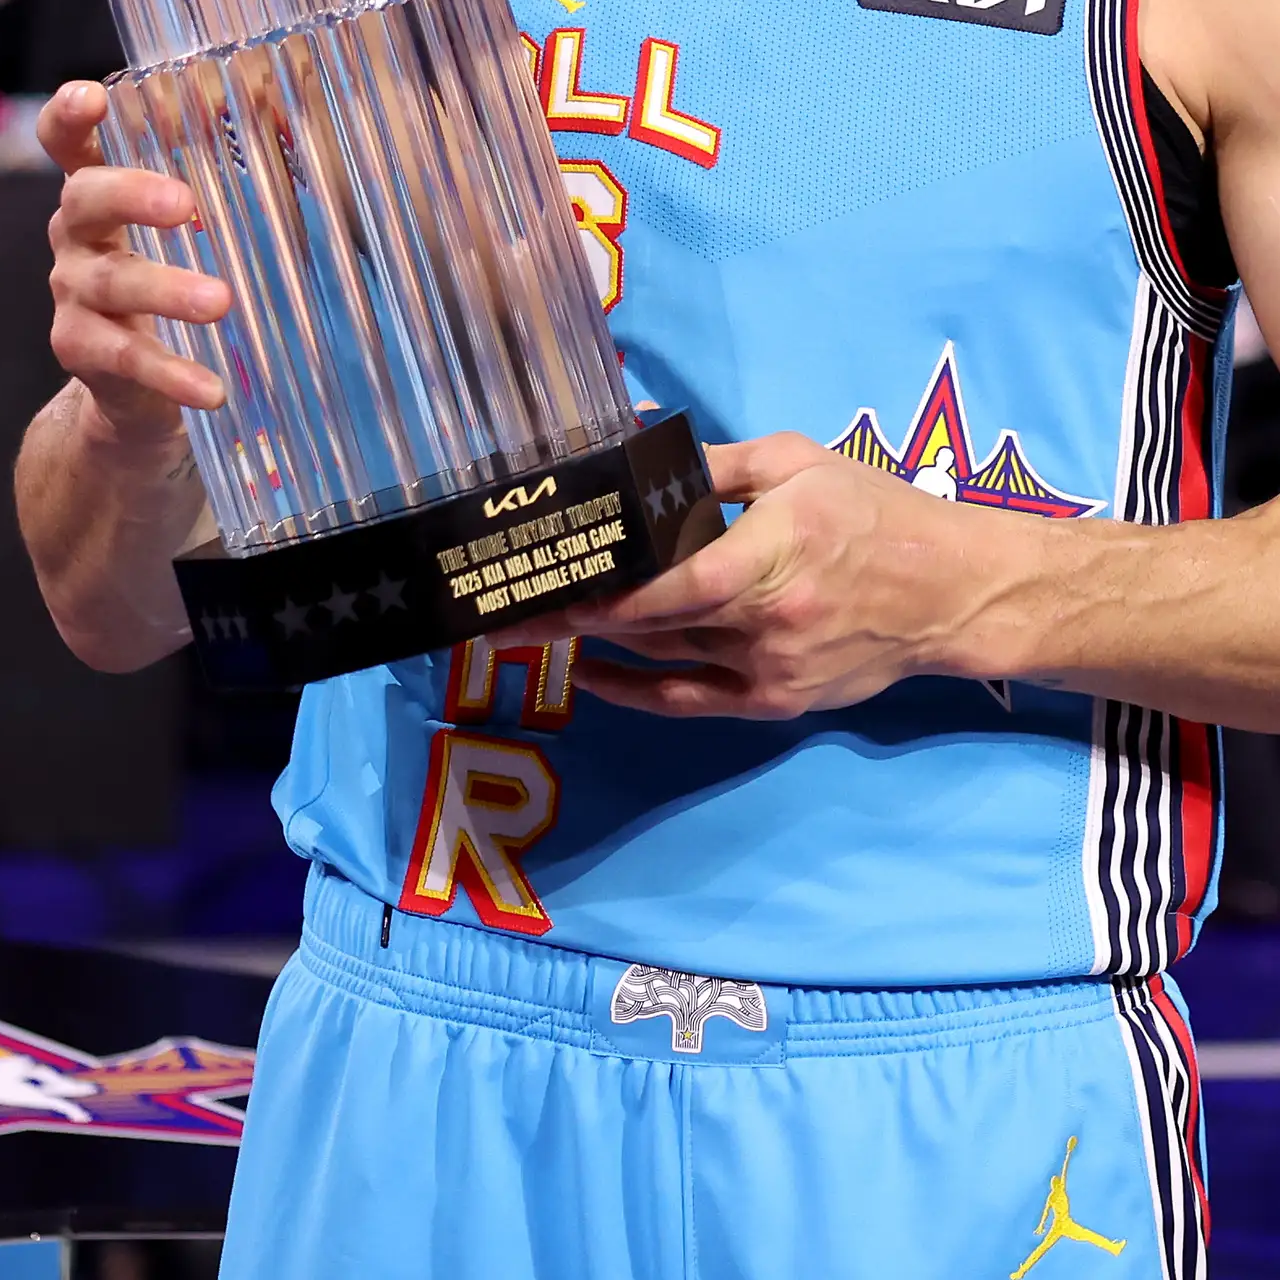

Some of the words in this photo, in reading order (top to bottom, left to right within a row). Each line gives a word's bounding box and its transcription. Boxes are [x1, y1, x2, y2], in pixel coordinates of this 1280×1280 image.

[519, 28, 722, 170] LL
[436, 545, 468, 574] THE
[467, 530, 509, 565] KOBE
[508, 511, 565, 551] BRYANT
[566, 491, 622, 529] TROPHY
[483, 475, 558, 518] KIA
[449, 570, 483, 599] 2025
[481, 562, 506, 587] KIA
[504, 553, 533, 579] NBA
[532, 532, 590, 569] ALL-STAR
[588, 519, 627, 548] GAME
[475, 585, 511, 615] MOST
[509, 565, 570, 602] VALUABLE
[569, 550, 616, 583] PLAYER
